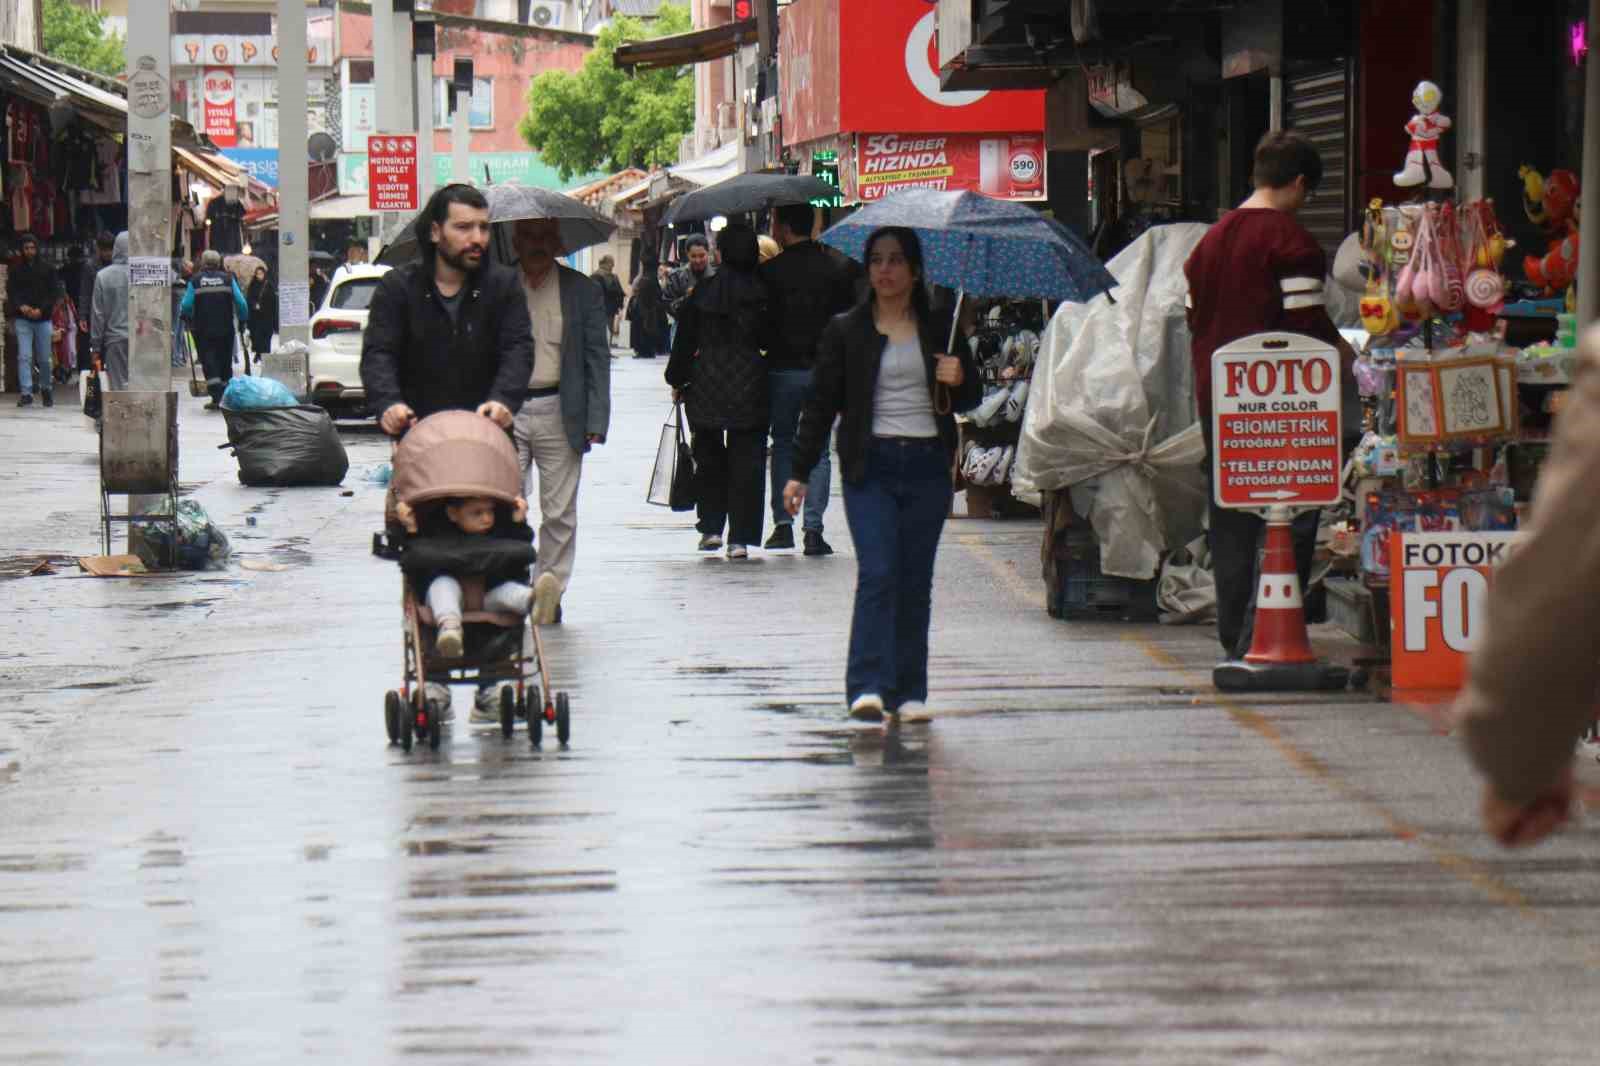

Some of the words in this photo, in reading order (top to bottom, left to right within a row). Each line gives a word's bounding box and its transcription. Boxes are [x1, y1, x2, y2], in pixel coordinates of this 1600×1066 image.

[864, 135, 897, 155] 5G
[864, 151, 947, 172] HIZINDA
[1012, 160, 1035, 170] 590
[864, 185, 881, 198] EV
[1223, 358, 1332, 398] FOTO
[1238, 402, 1267, 413] NUR
[1271, 400, 1319, 412] COLOR
